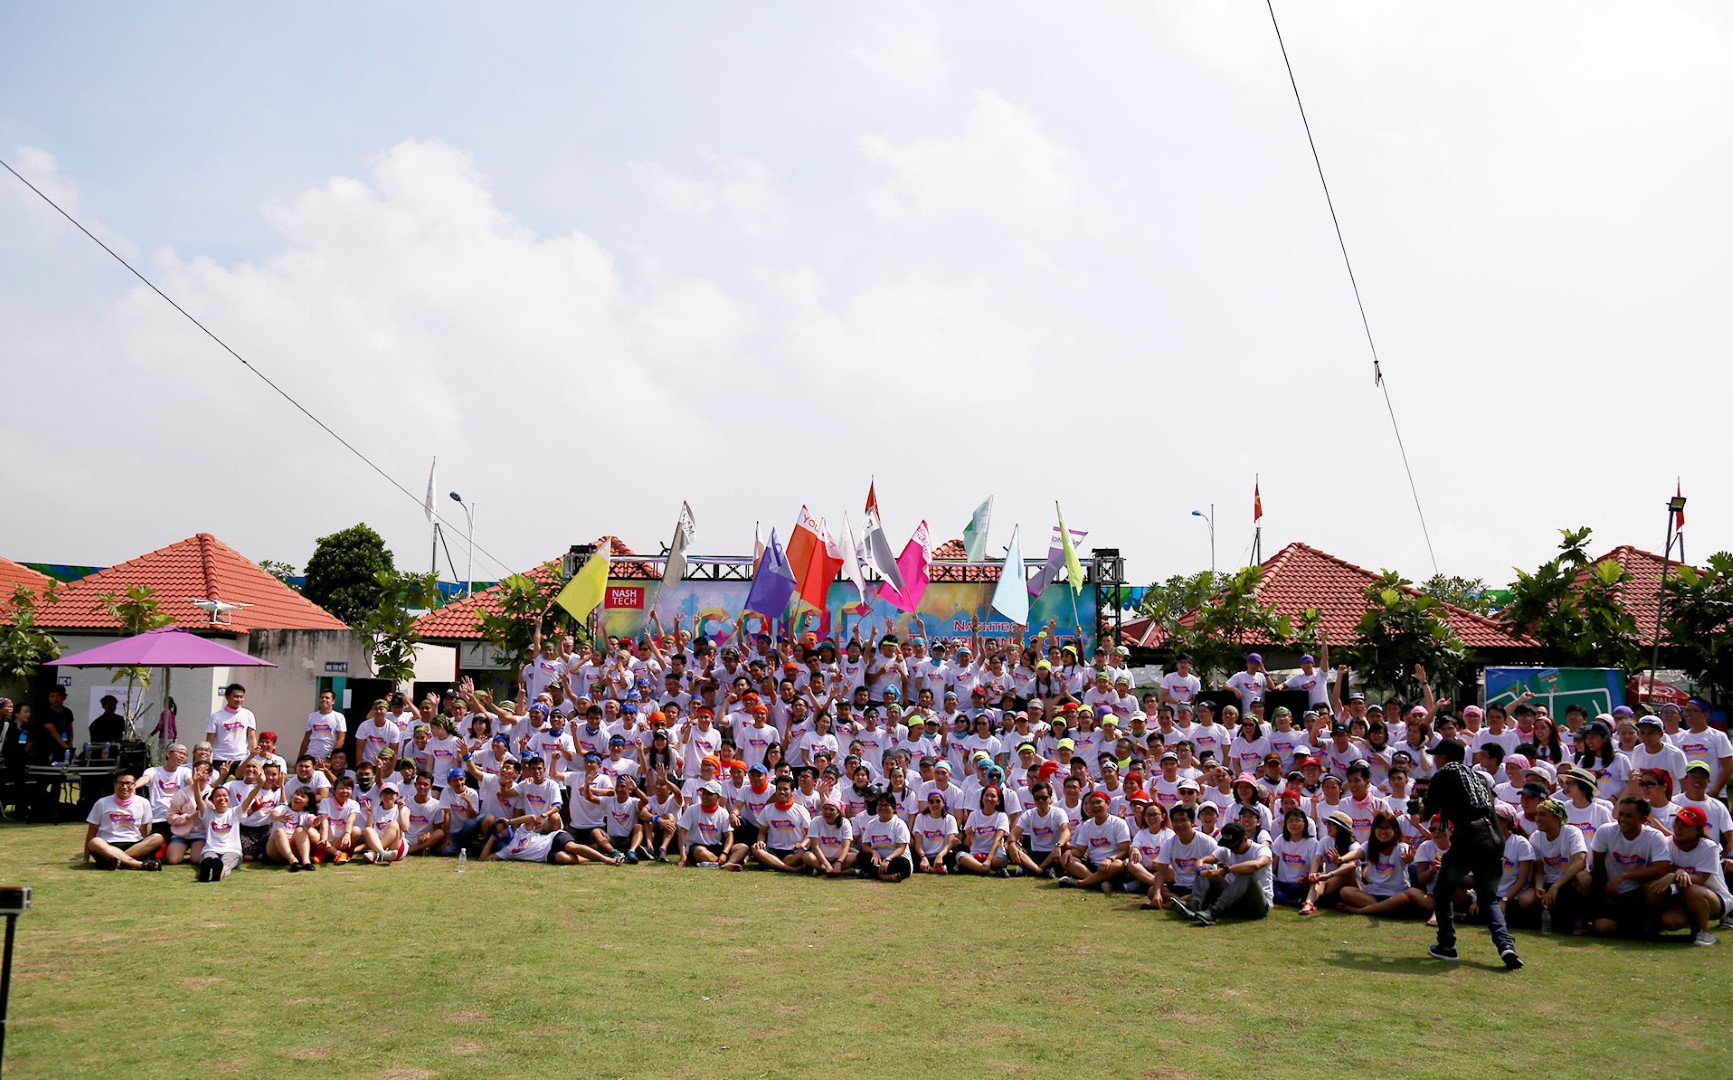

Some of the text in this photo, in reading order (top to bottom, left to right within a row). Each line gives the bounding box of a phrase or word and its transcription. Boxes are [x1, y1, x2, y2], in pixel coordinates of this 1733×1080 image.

[612, 589, 637, 597] NASH
[612, 597, 637, 605] TECH
[1652, 696, 1678, 704] WALL'S
